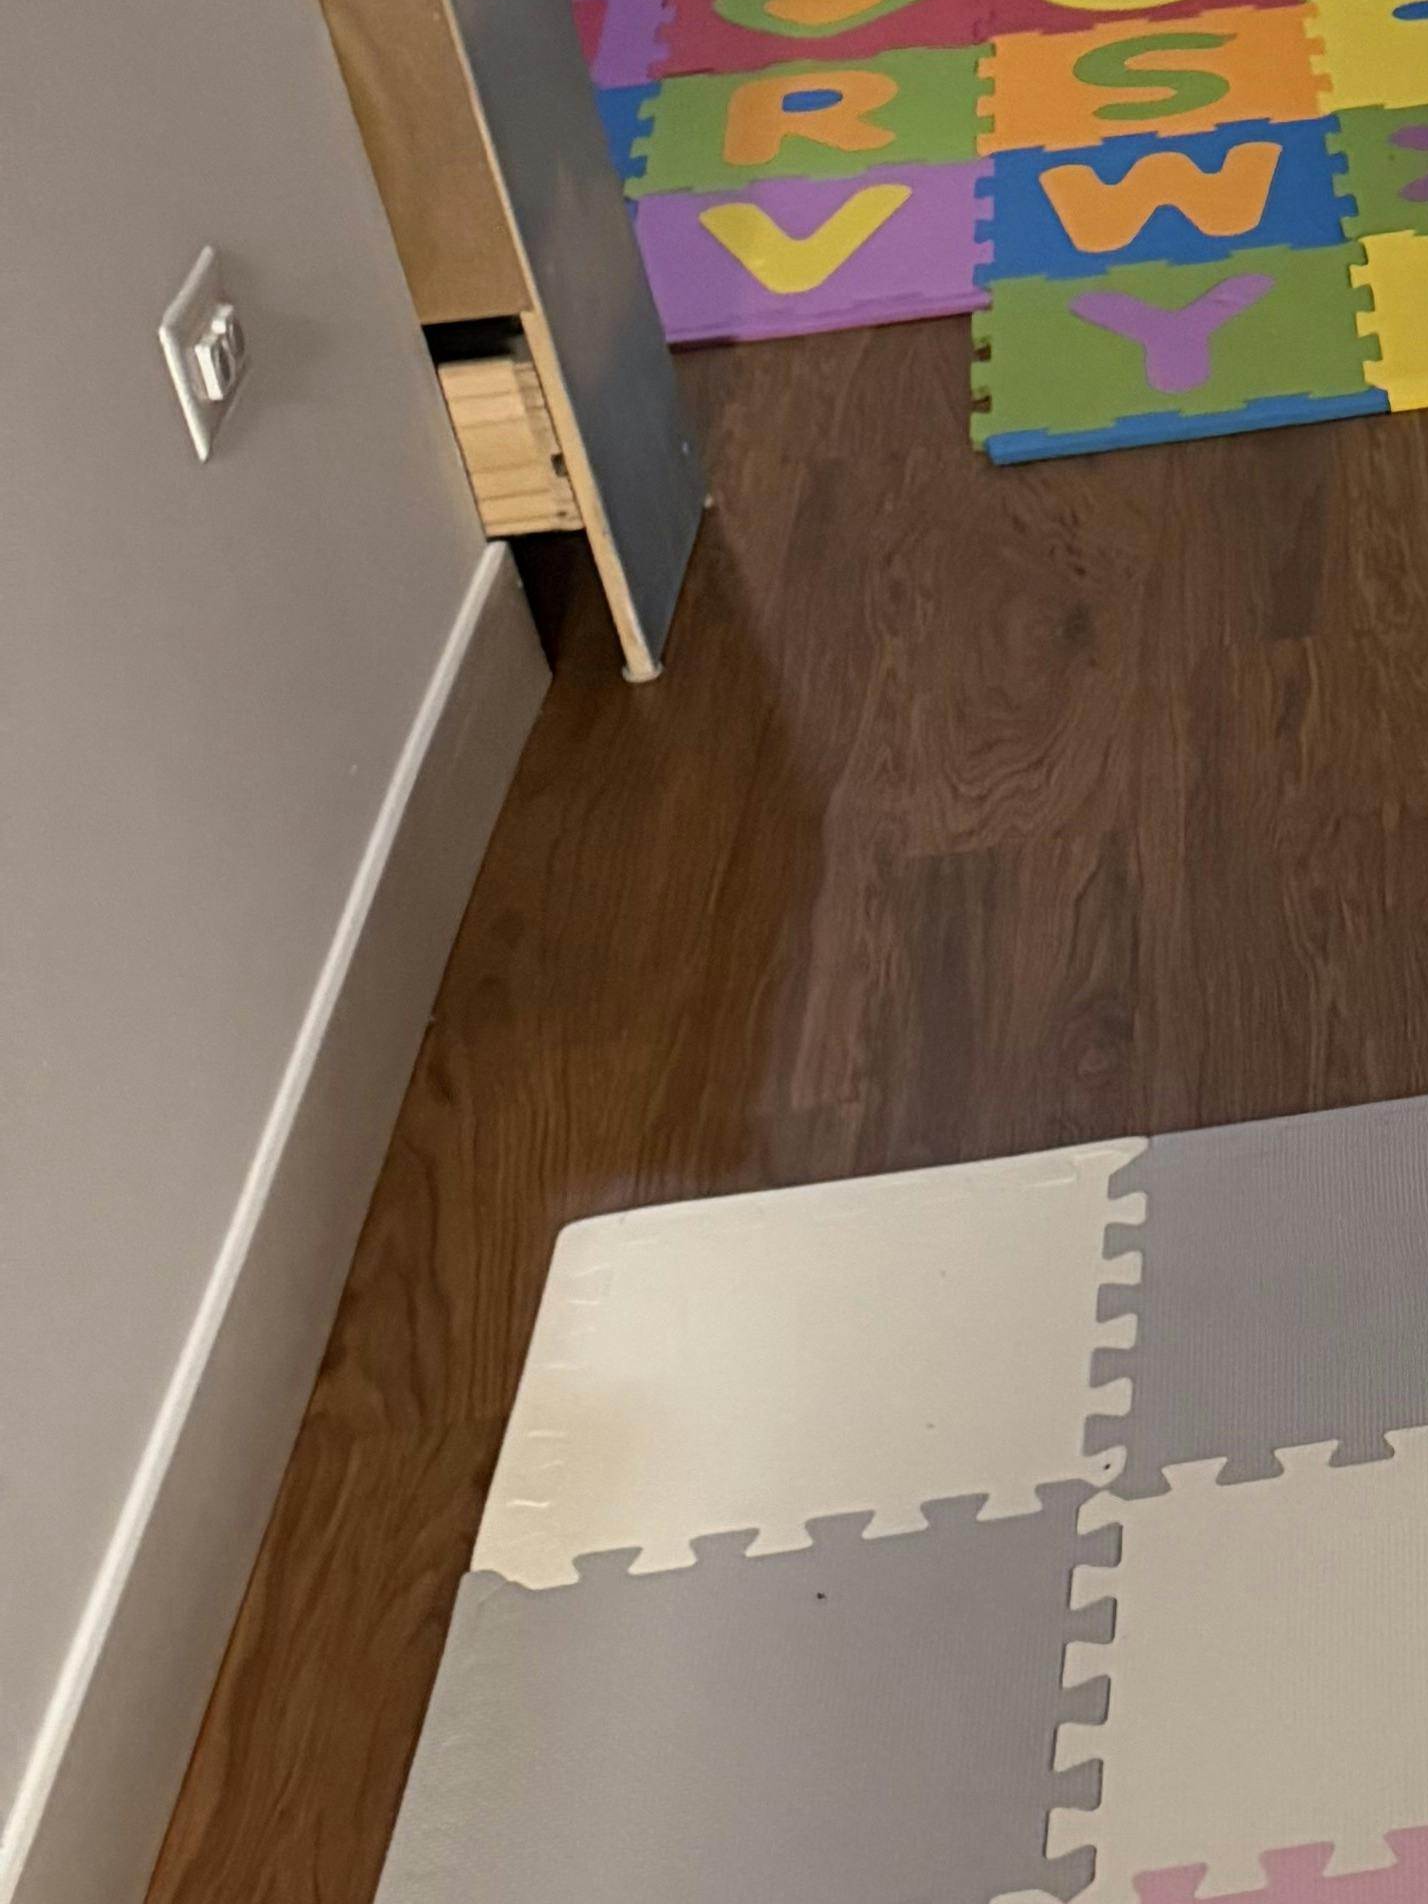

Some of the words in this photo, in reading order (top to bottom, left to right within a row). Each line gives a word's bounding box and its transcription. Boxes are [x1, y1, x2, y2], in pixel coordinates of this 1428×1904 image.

[722, 70, 899, 166] R
[1072, 31, 1239, 122] S
[699, 183, 912, 294] V
[1038, 141, 1283, 254] W
[1068, 272, 1277, 395] Y
